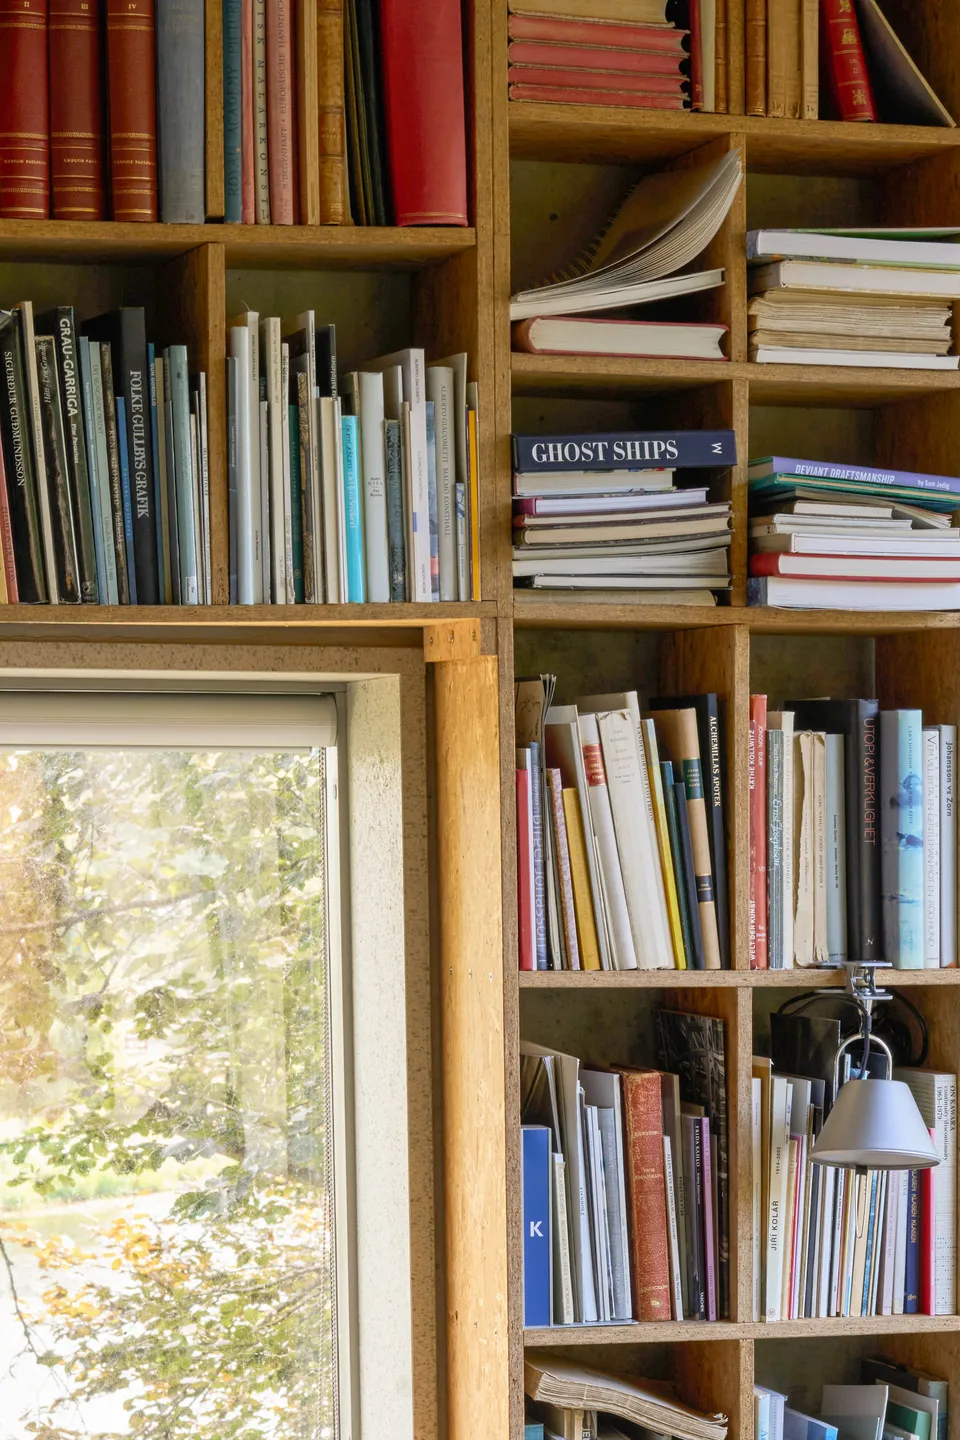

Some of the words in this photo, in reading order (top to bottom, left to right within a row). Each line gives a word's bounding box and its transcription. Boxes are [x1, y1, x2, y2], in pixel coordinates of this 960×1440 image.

[59, 318, 78, 416] GRAU-GARRIGA
[130, 370, 143, 412] FOLKE
[132, 414, 146, 469] GULLBYS
[795, 464, 829, 477] DEVIANT
[830, 468, 895, 484] DRAFTSMANSHIP
[135, 471, 149, 519] GRAFIK
[710, 716, 720, 774] ALCHEMILLAS
[863, 718, 875, 755] UTOPI
[927, 736, 937, 755] VEM
[927, 759, 935, 772] VILL
[945, 742, 954, 783] Johansson
[927, 775, 935, 794] BYTA
[946, 785, 952, 795] vs
[927, 814, 935, 863] GENTLEMAN
[927, 901, 936, 919] RÖD
[530, 1221, 543, 1237] K
